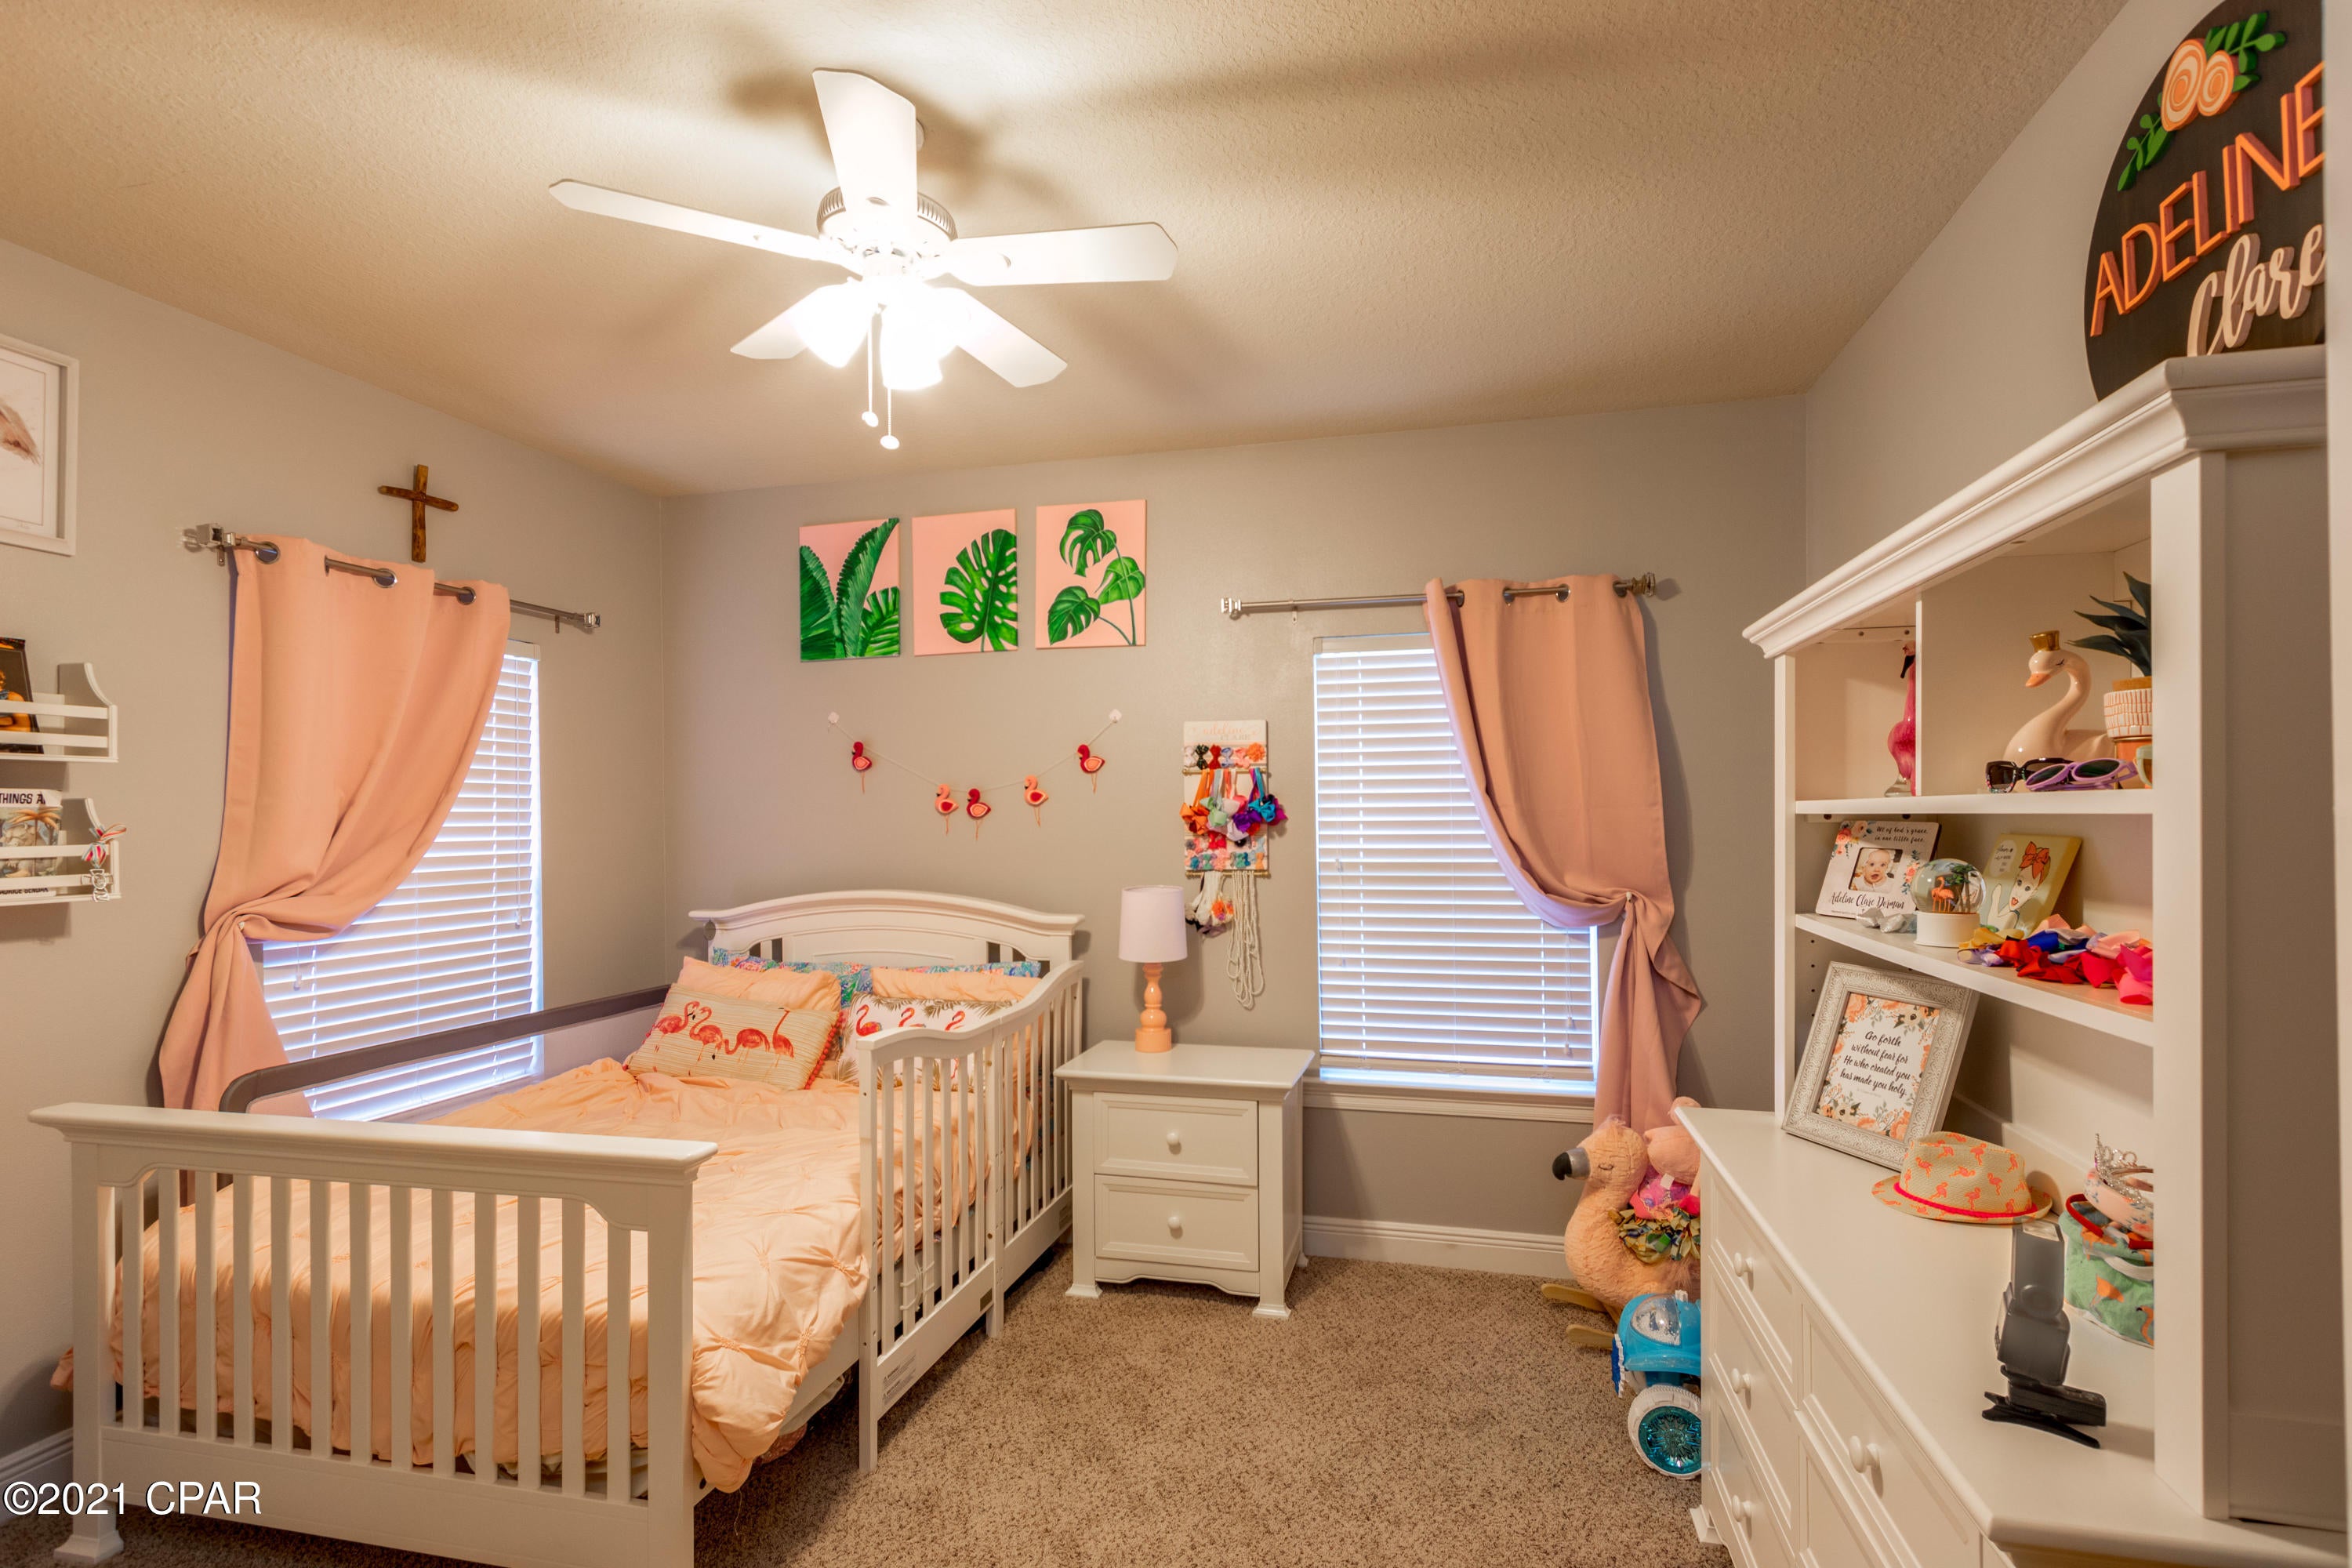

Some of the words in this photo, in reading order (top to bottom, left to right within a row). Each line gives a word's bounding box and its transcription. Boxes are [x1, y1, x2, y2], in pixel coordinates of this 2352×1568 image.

[2091, 61, 2325, 337] ADELINE
[2187, 223, 2326, 358] Clare
[1831, 891, 1855, 905] Adeline
[1857, 894, 1875, 907] Clare
[1877, 896, 1905, 910] Dorman
[1865, 1031, 1877, 1041] Go
[1878, 1034, 1901, 1047] forth
[1844, 1054, 1853, 1065] He
[1854, 1058, 1869, 1069] who
[1870, 1063, 1897, 1076] created
[1895, 1071, 1911, 1082] you
[1851, 1044, 1881, 1057] without
[1879, 1050, 1896, 1061] fear
[1895, 1053, 1908, 1065] for
[1840, 1068, 1853, 1080] has
[1853, 1074, 1872, 1085] made
[1872, 1080, 1887, 1091] you
[1888, 1081, 1907, 1098] holy.
